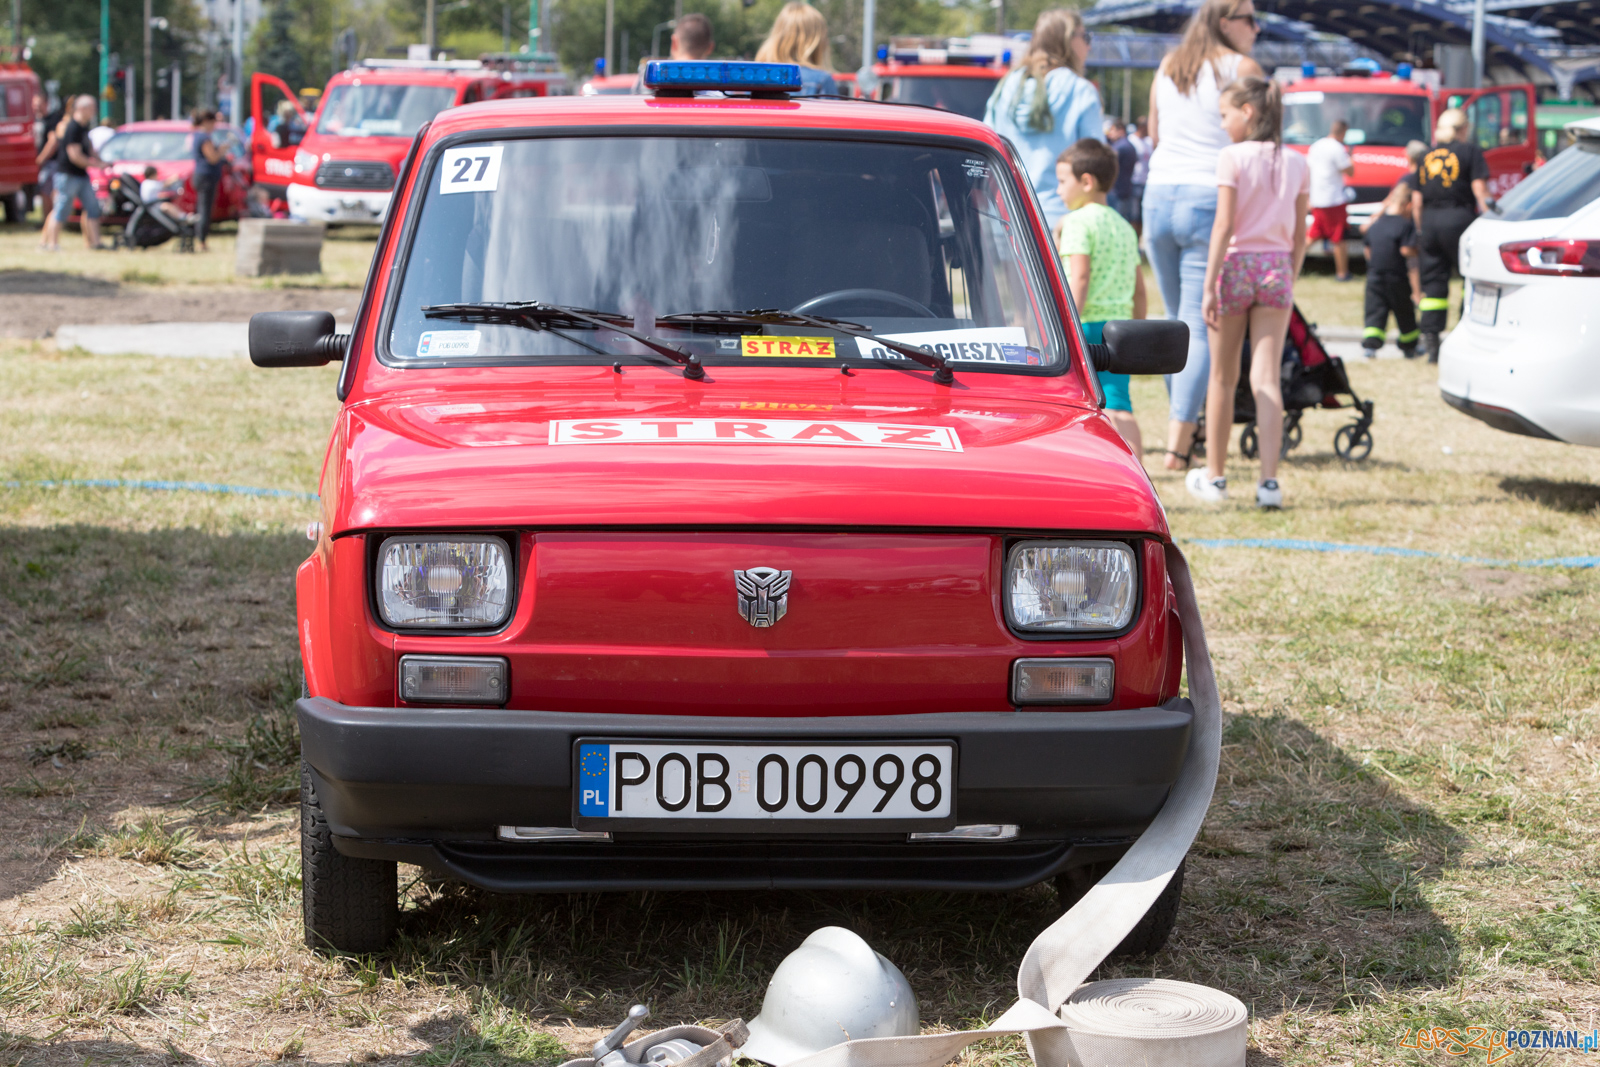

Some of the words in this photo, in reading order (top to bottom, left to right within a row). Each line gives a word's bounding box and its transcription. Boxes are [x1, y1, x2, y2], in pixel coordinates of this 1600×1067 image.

[451, 156, 491, 183] 27
[614, 752, 732, 812] POB
[756, 753, 942, 813] 00998
[583, 790, 604, 805] PL
